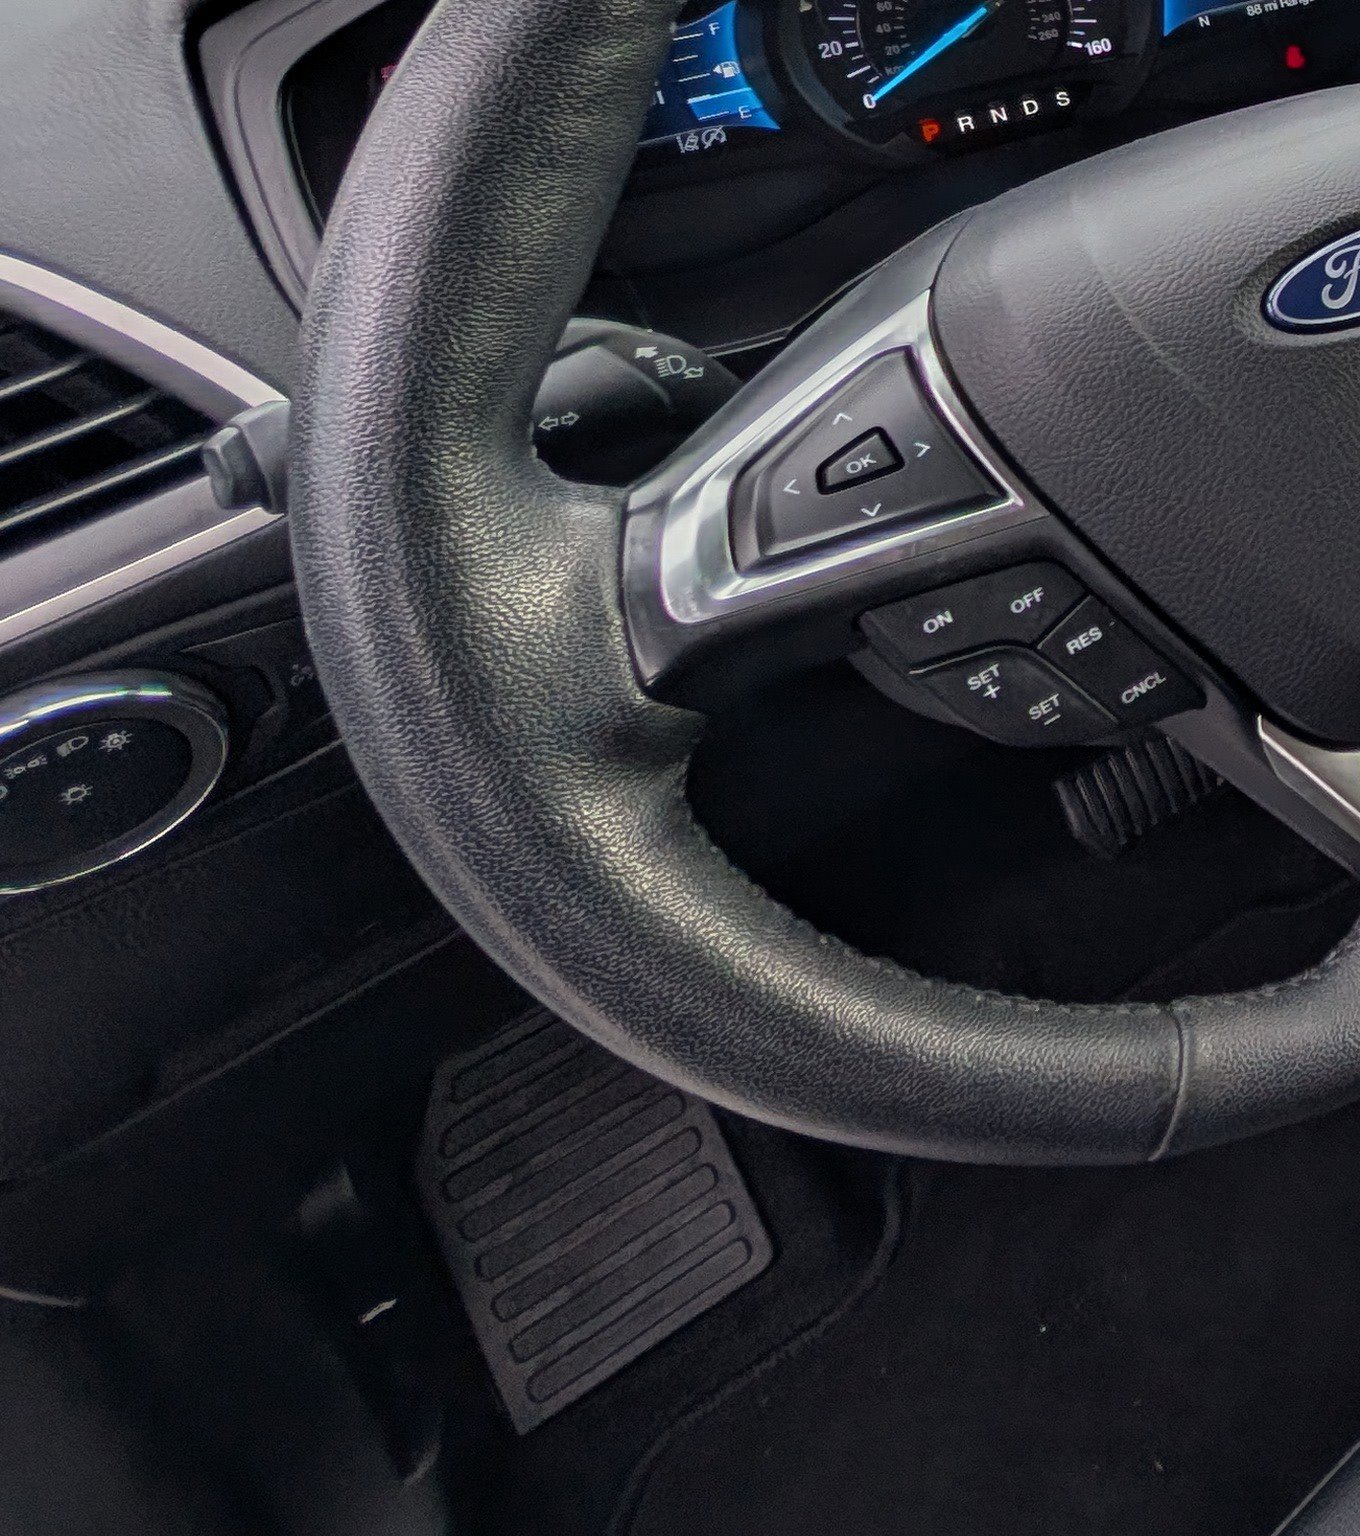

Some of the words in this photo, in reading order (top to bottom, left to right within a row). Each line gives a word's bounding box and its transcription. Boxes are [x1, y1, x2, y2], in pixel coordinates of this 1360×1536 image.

[1041, 11, 1062, 23] 240
[1198, 16, 1211, 28] N
[1264, 0, 1279, 12] mi
[709, 22, 720, 36] F
[875, 23, 891, 33] 40
[818, 41, 843, 59] 20
[885, 45, 900, 56] 20
[1084, 38, 1112, 56] 160
[738, 105, 752, 119] E
[863, 94, 876, 109] 0
[921, 121, 941, 142] P
[957, 116, 975, 133] R
[990, 106, 1008, 123] N
[1022, 99, 1039, 115] D
[1056, 91, 1071, 107] S
[845, 452, 877, 476] OK
[1010, 586, 1045, 614] OFF
[922, 610, 953, 634] ON
[1066, 627, 1103, 655] RES
[967, 664, 1000, 692] SET
[1120, 671, 1167, 705] CNCL
[1028, 693, 1060, 722] SET
